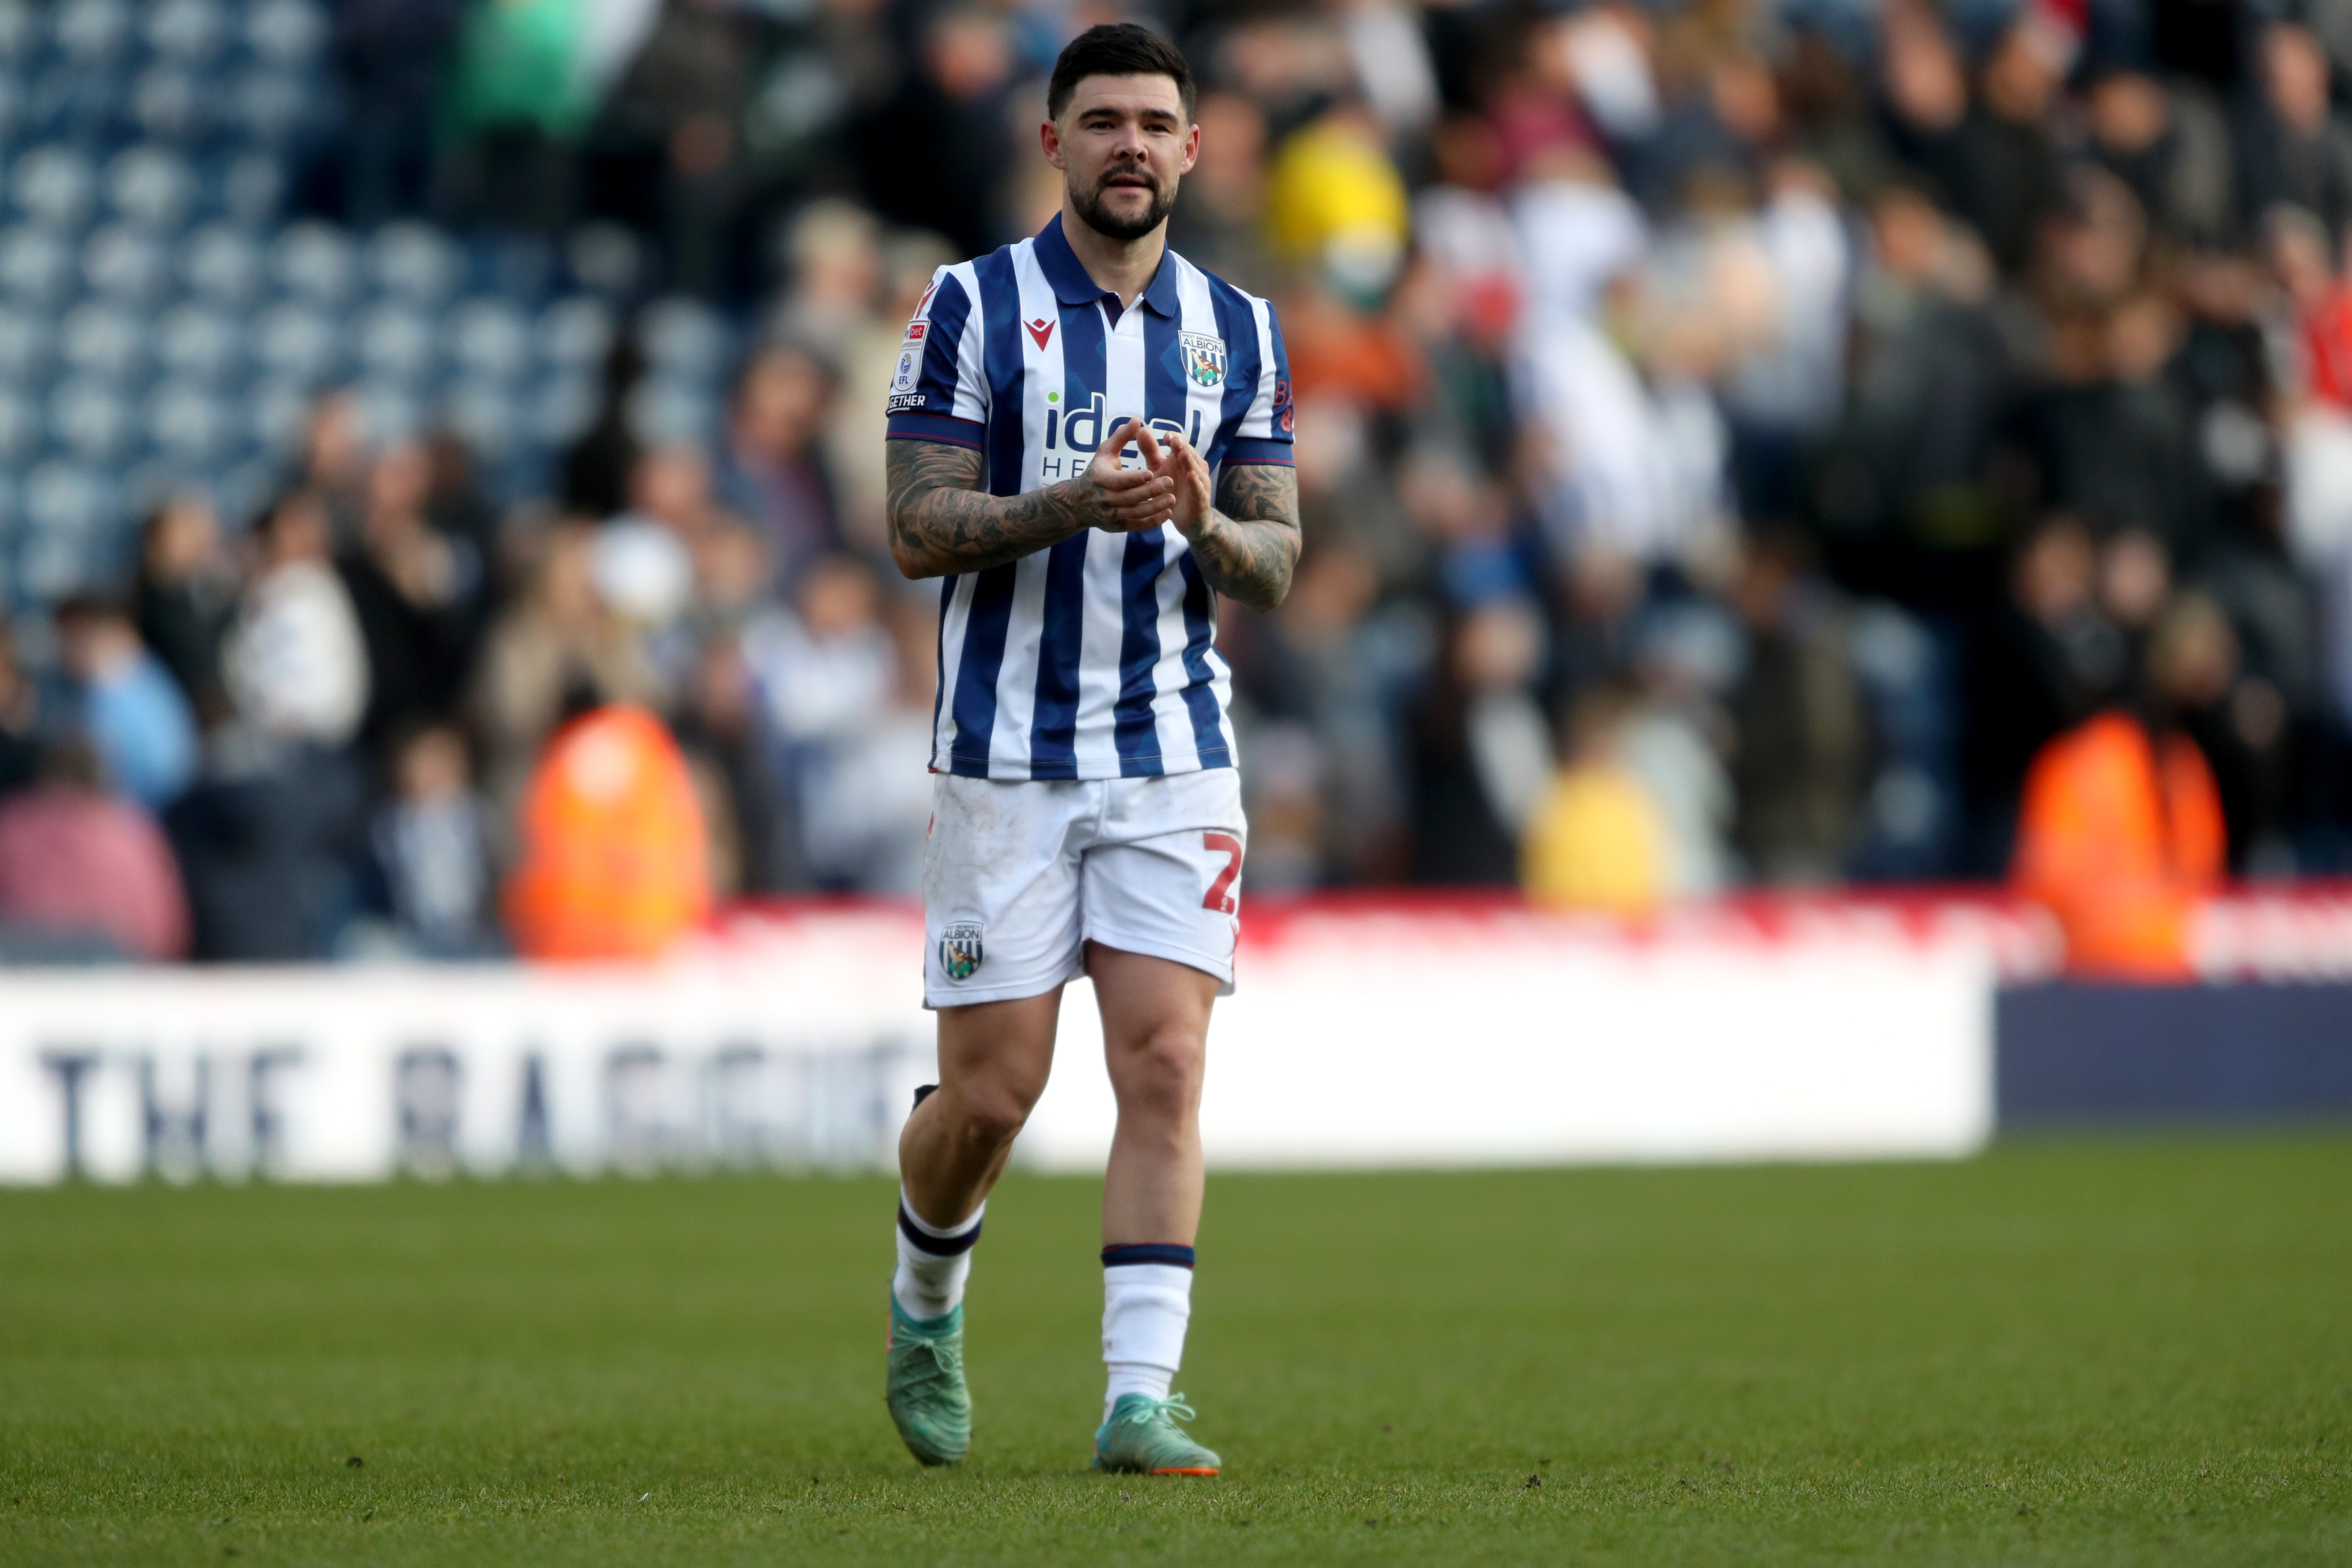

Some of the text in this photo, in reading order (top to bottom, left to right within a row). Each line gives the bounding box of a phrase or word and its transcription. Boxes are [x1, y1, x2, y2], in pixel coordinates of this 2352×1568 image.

[910, 326, 923, 336] bet
[1183, 337, 1222, 354] ALBION
[1196, 336, 1222, 345] BROMWICH
[899, 376, 908, 384] EFL
[890, 395, 925, 408] GETHER
[1202, 832, 1242, 914] 2
[943, 929, 979, 939] ALBION
